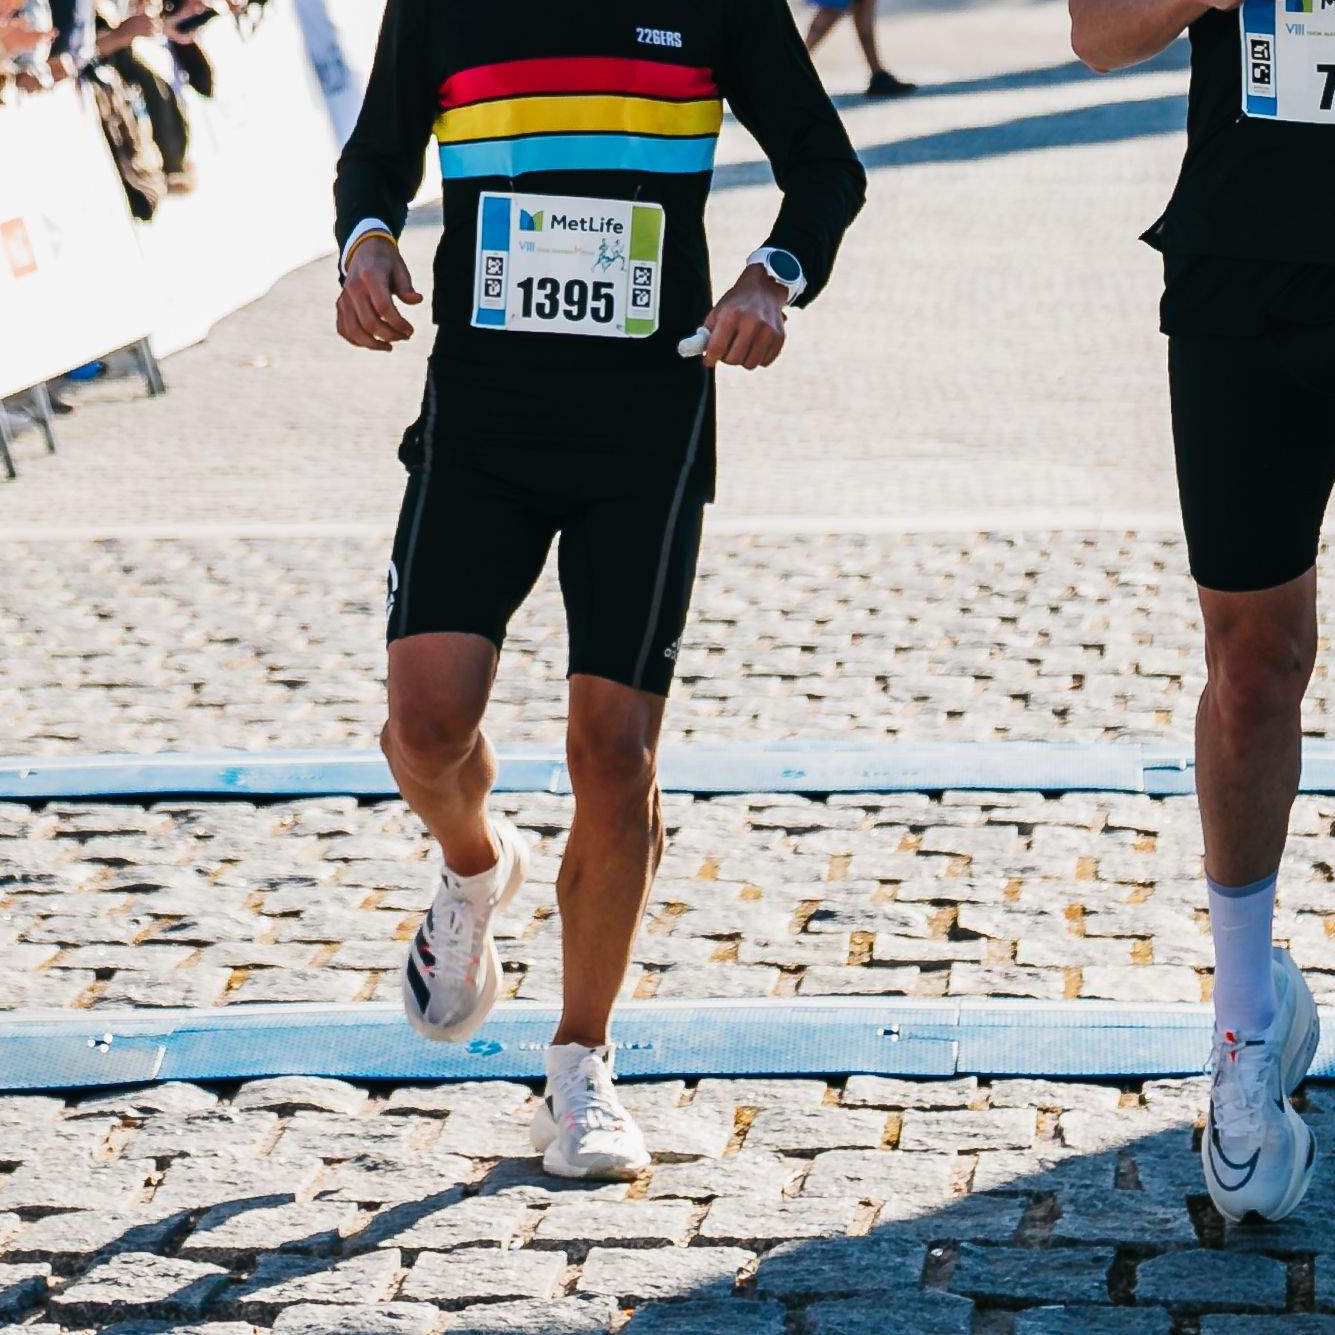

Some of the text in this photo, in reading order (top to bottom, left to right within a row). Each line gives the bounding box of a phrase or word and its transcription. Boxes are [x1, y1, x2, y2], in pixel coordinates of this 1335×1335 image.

[635, 27, 683, 48] 226ERS
[550, 214, 624, 235] MetLife
[516, 276, 615, 325] 1395
